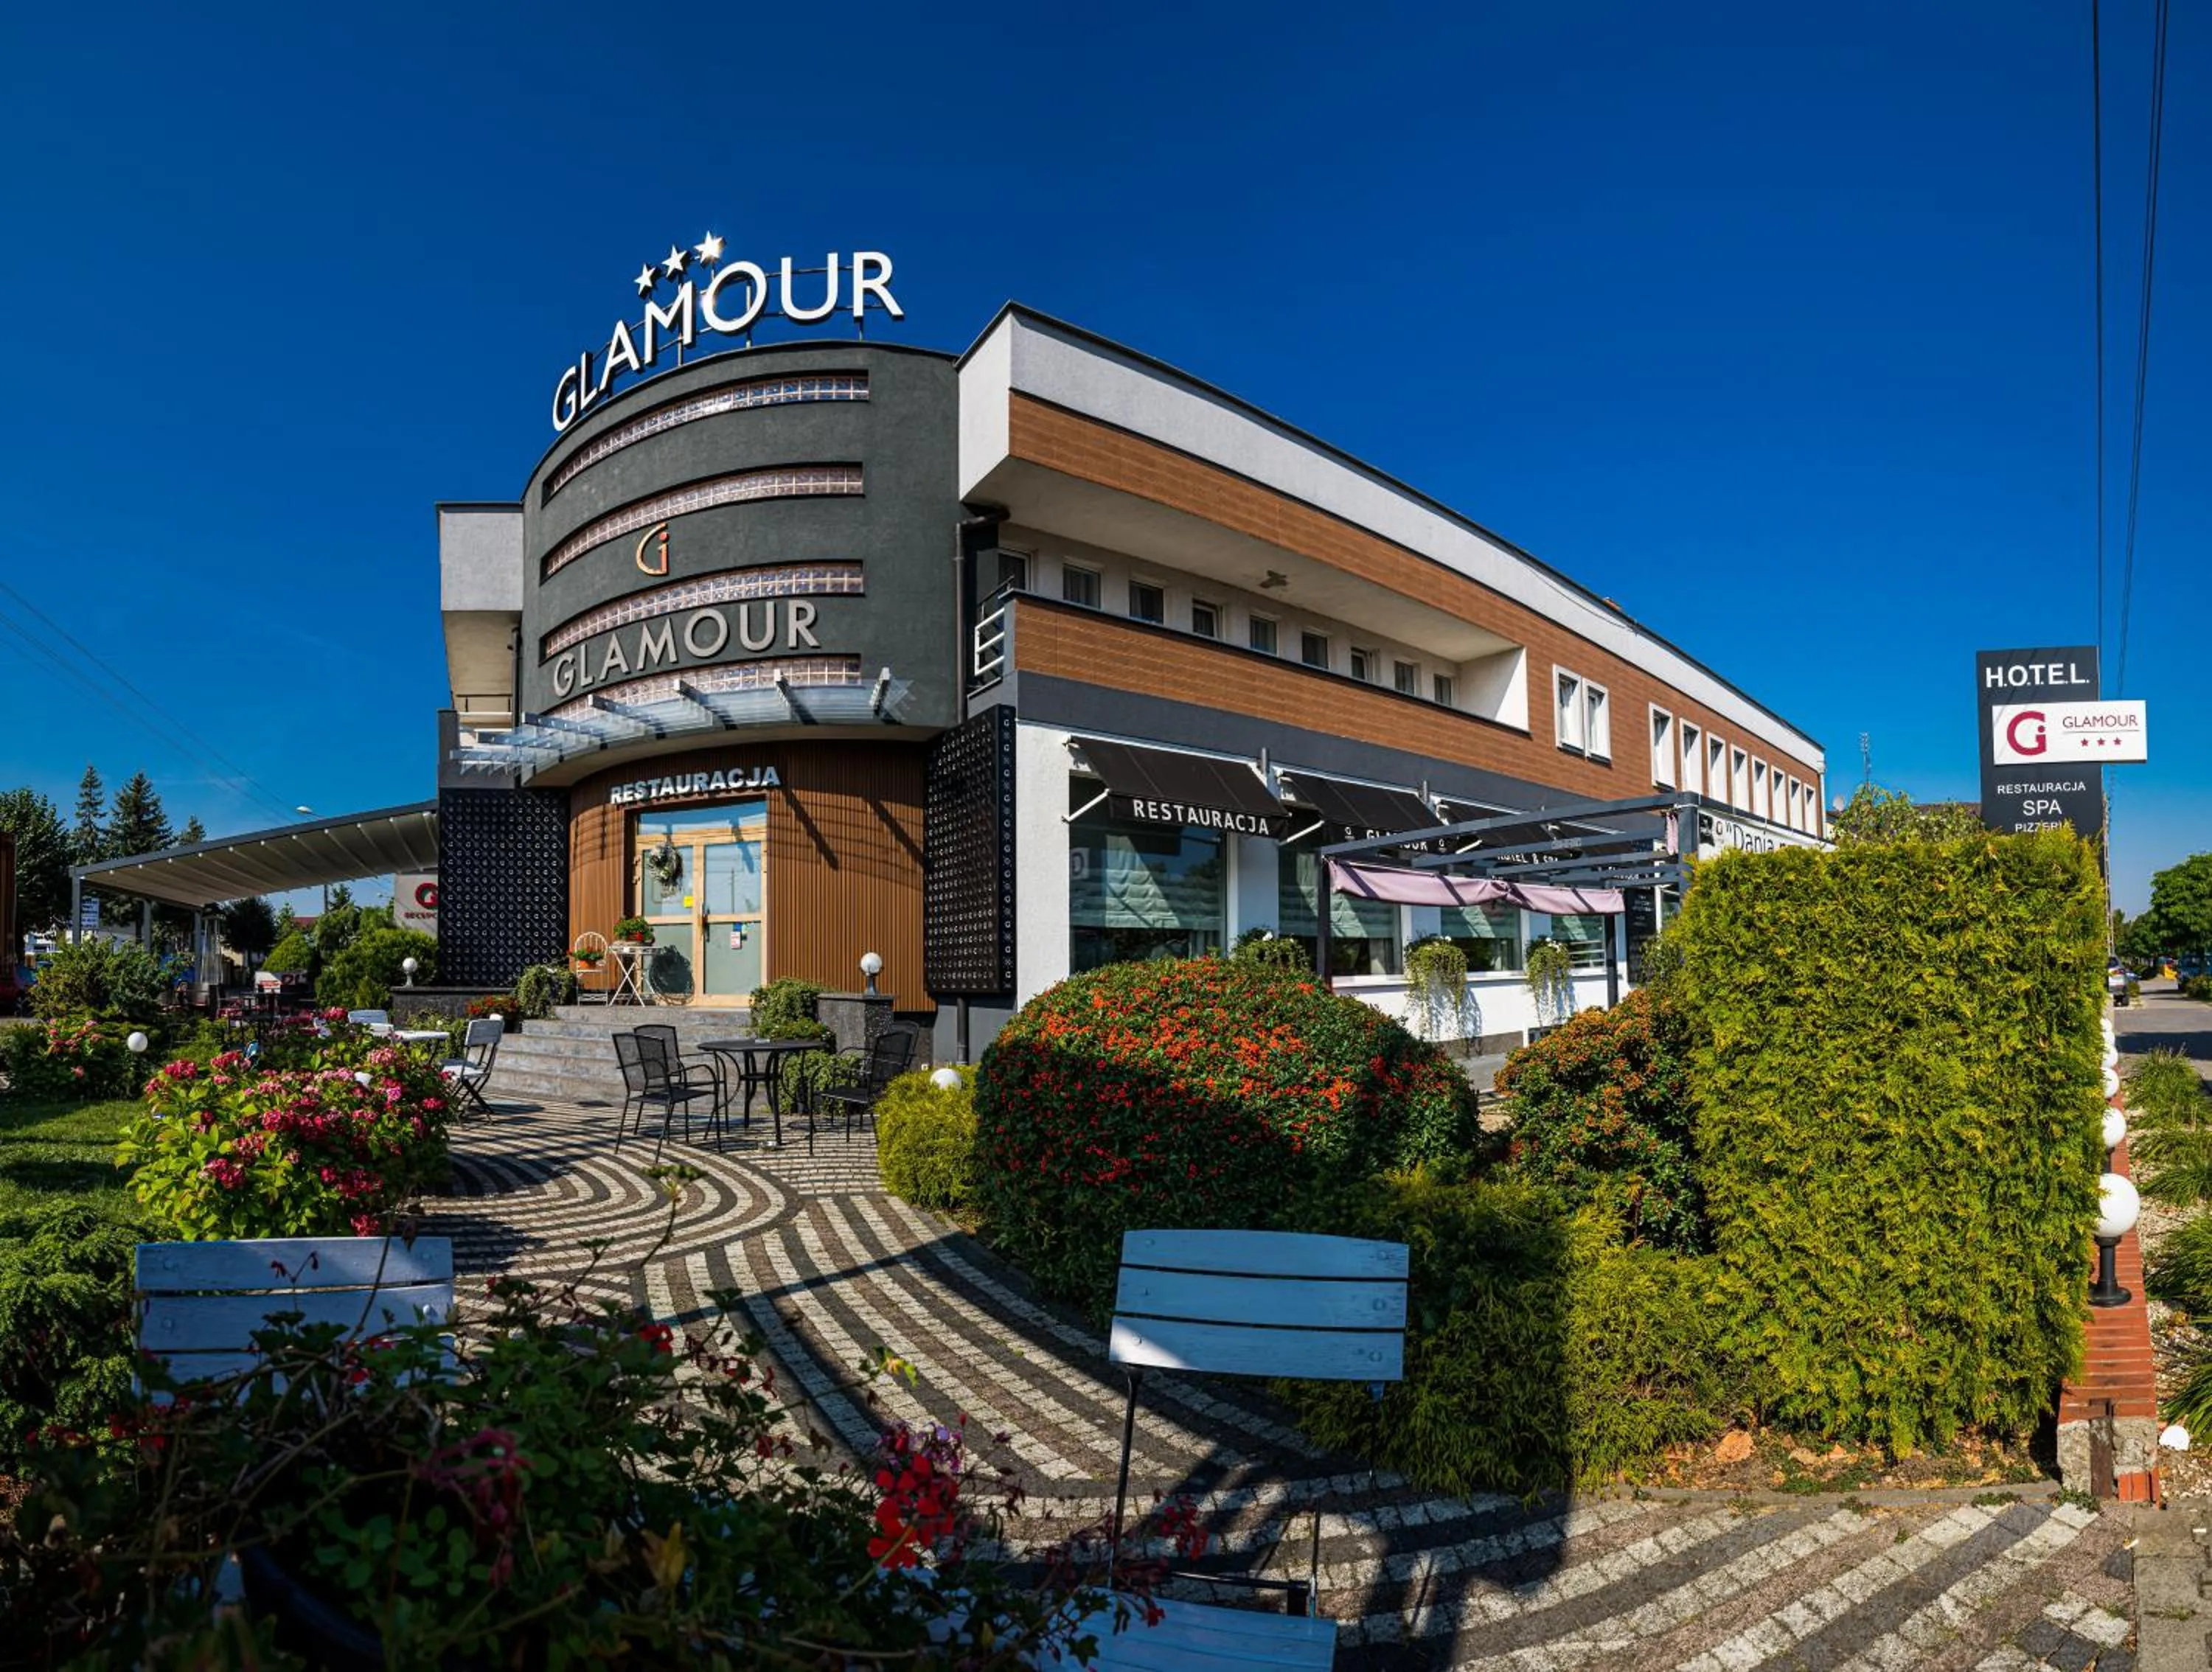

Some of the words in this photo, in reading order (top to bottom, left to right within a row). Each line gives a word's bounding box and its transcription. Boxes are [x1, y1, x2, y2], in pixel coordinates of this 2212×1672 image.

[552, 251, 904, 431] GLAMOUR
[553, 599, 821, 697] GLAMOUR
[2062, 714, 2138, 728] GLAMOUR
[611, 766, 782, 804] RESTAURACJA
[1997, 781, 2086, 795] RESTAURACJA
[1133, 798, 1269, 835] RESTAURACJA
[2023, 798, 2062, 816] SPA
